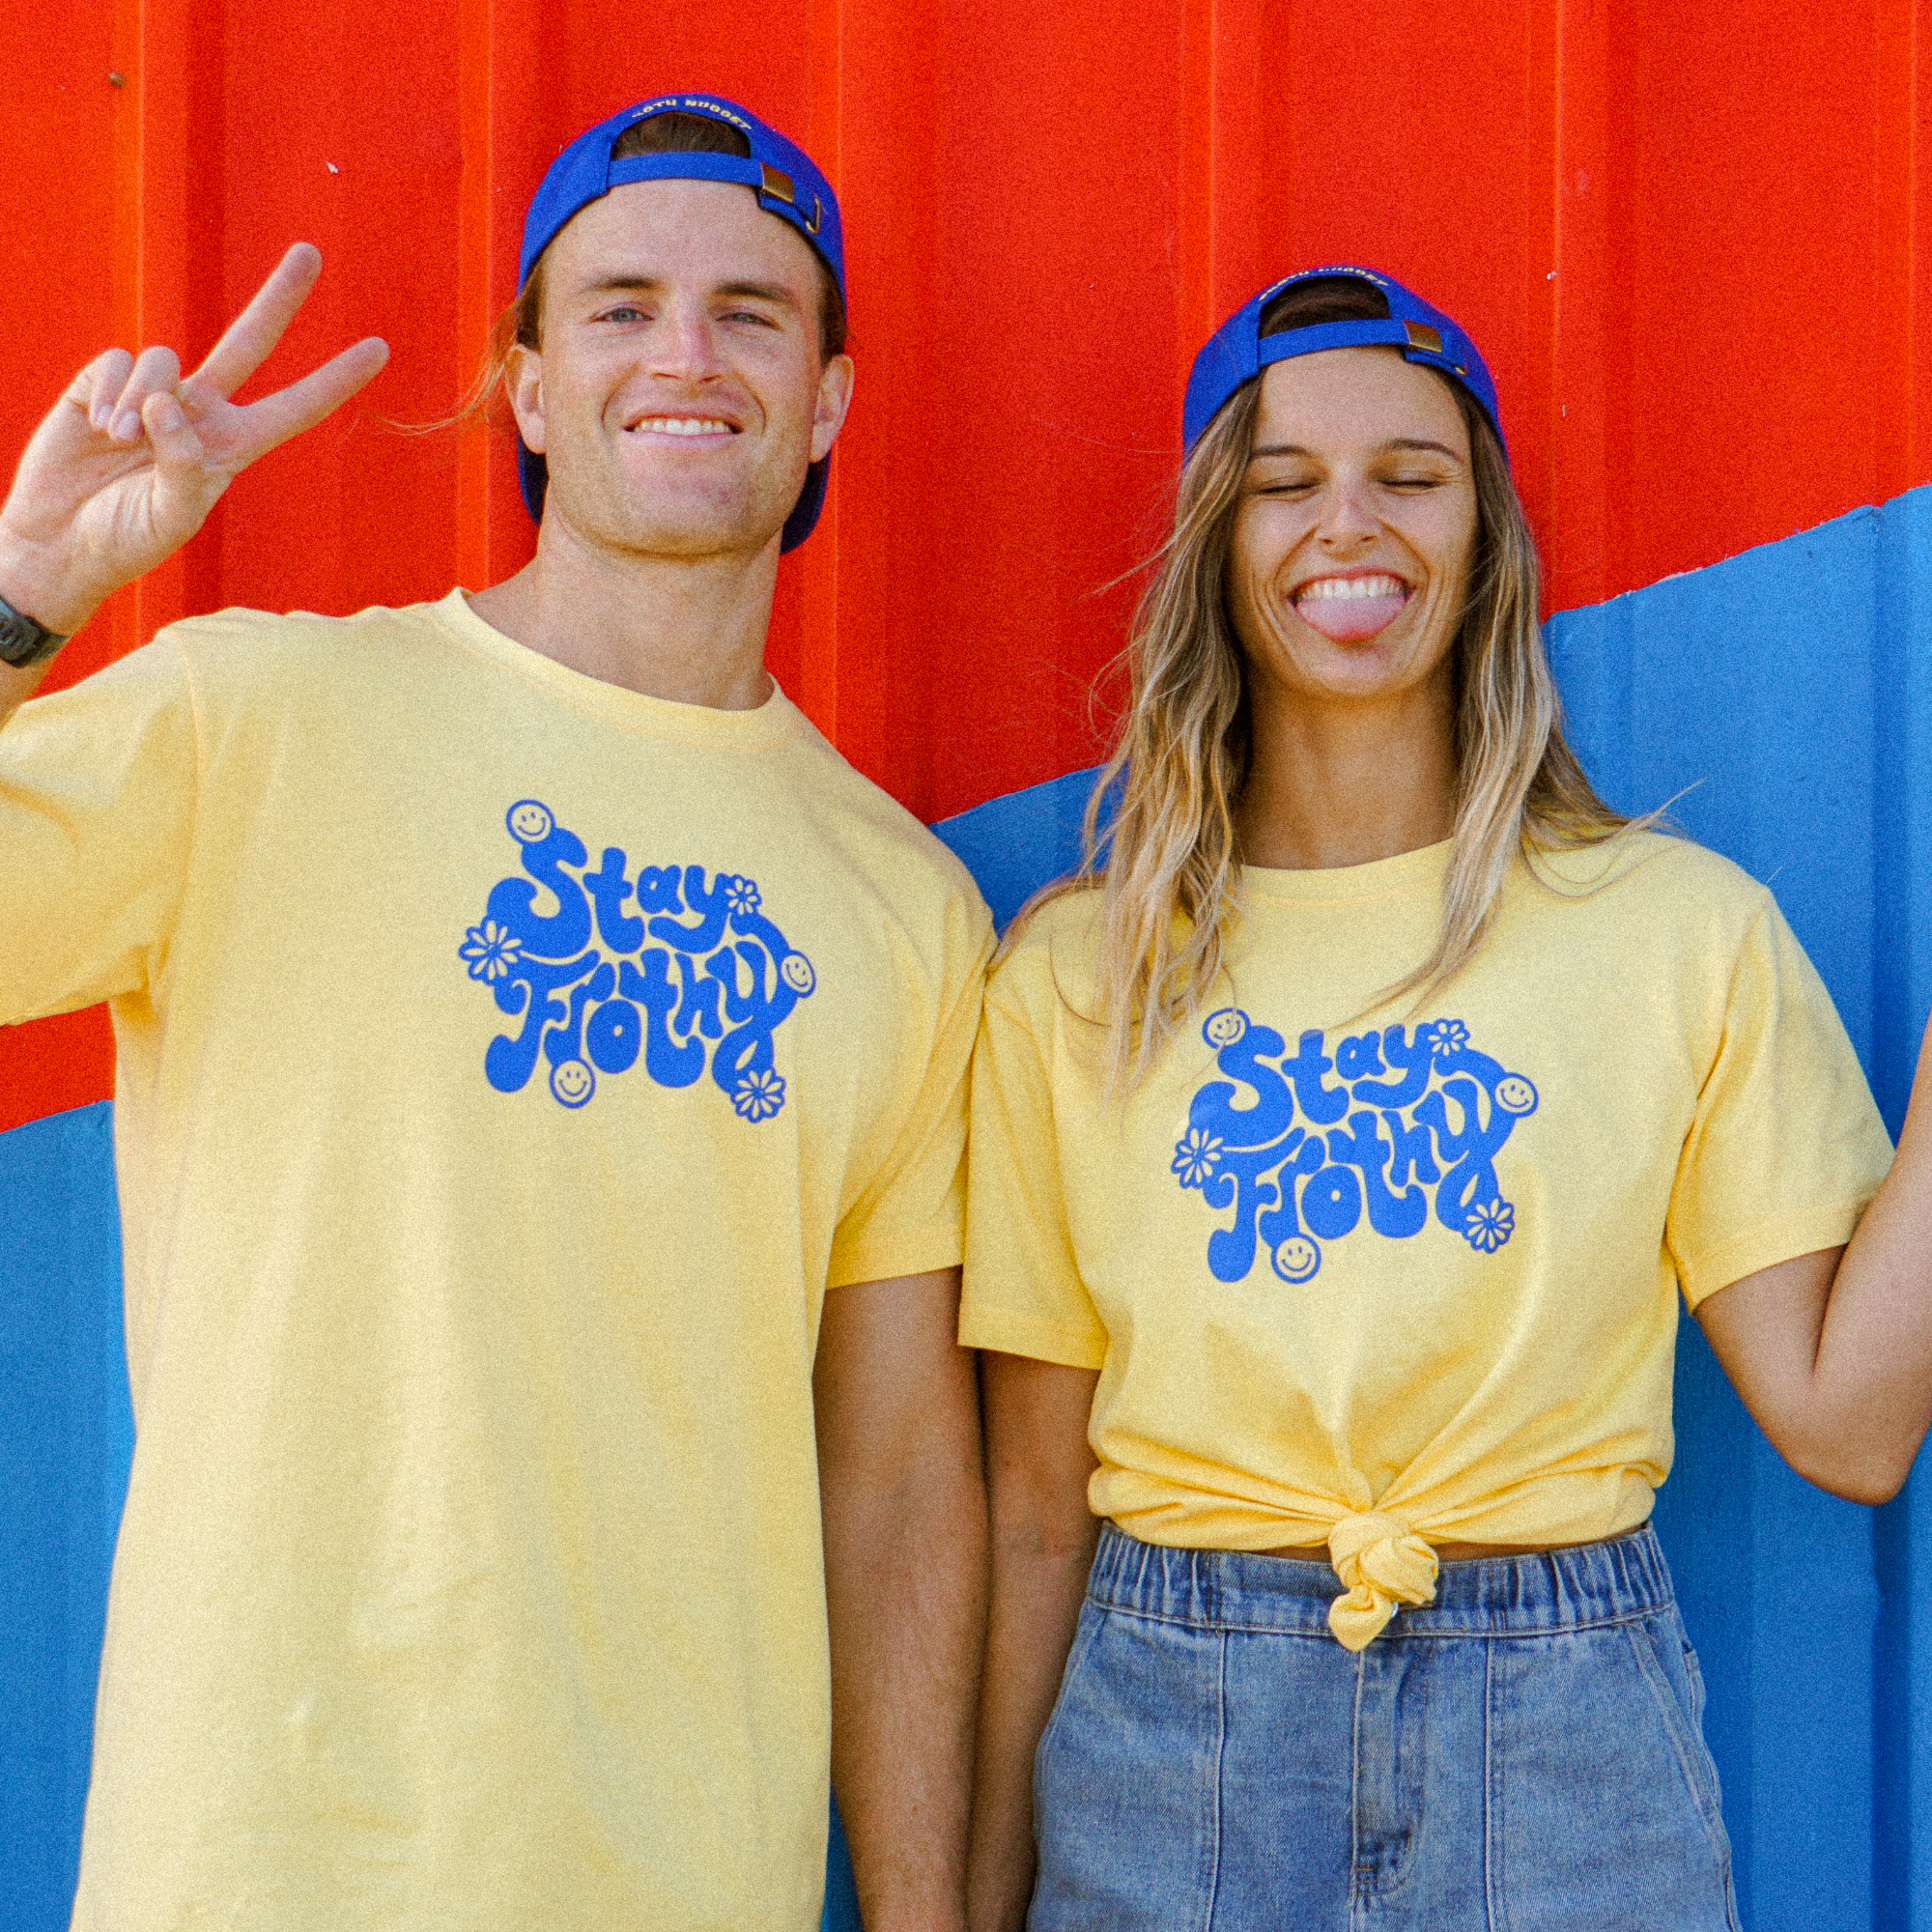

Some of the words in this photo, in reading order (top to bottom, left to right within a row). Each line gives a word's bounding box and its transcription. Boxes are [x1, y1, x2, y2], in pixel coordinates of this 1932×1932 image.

[486, 826, 737, 959] Stay
[485, 914, 800, 1094] Frothy
[1188, 1023, 1435, 1147] Stay
[1201, 1049, 1517, 1284] Frothy
